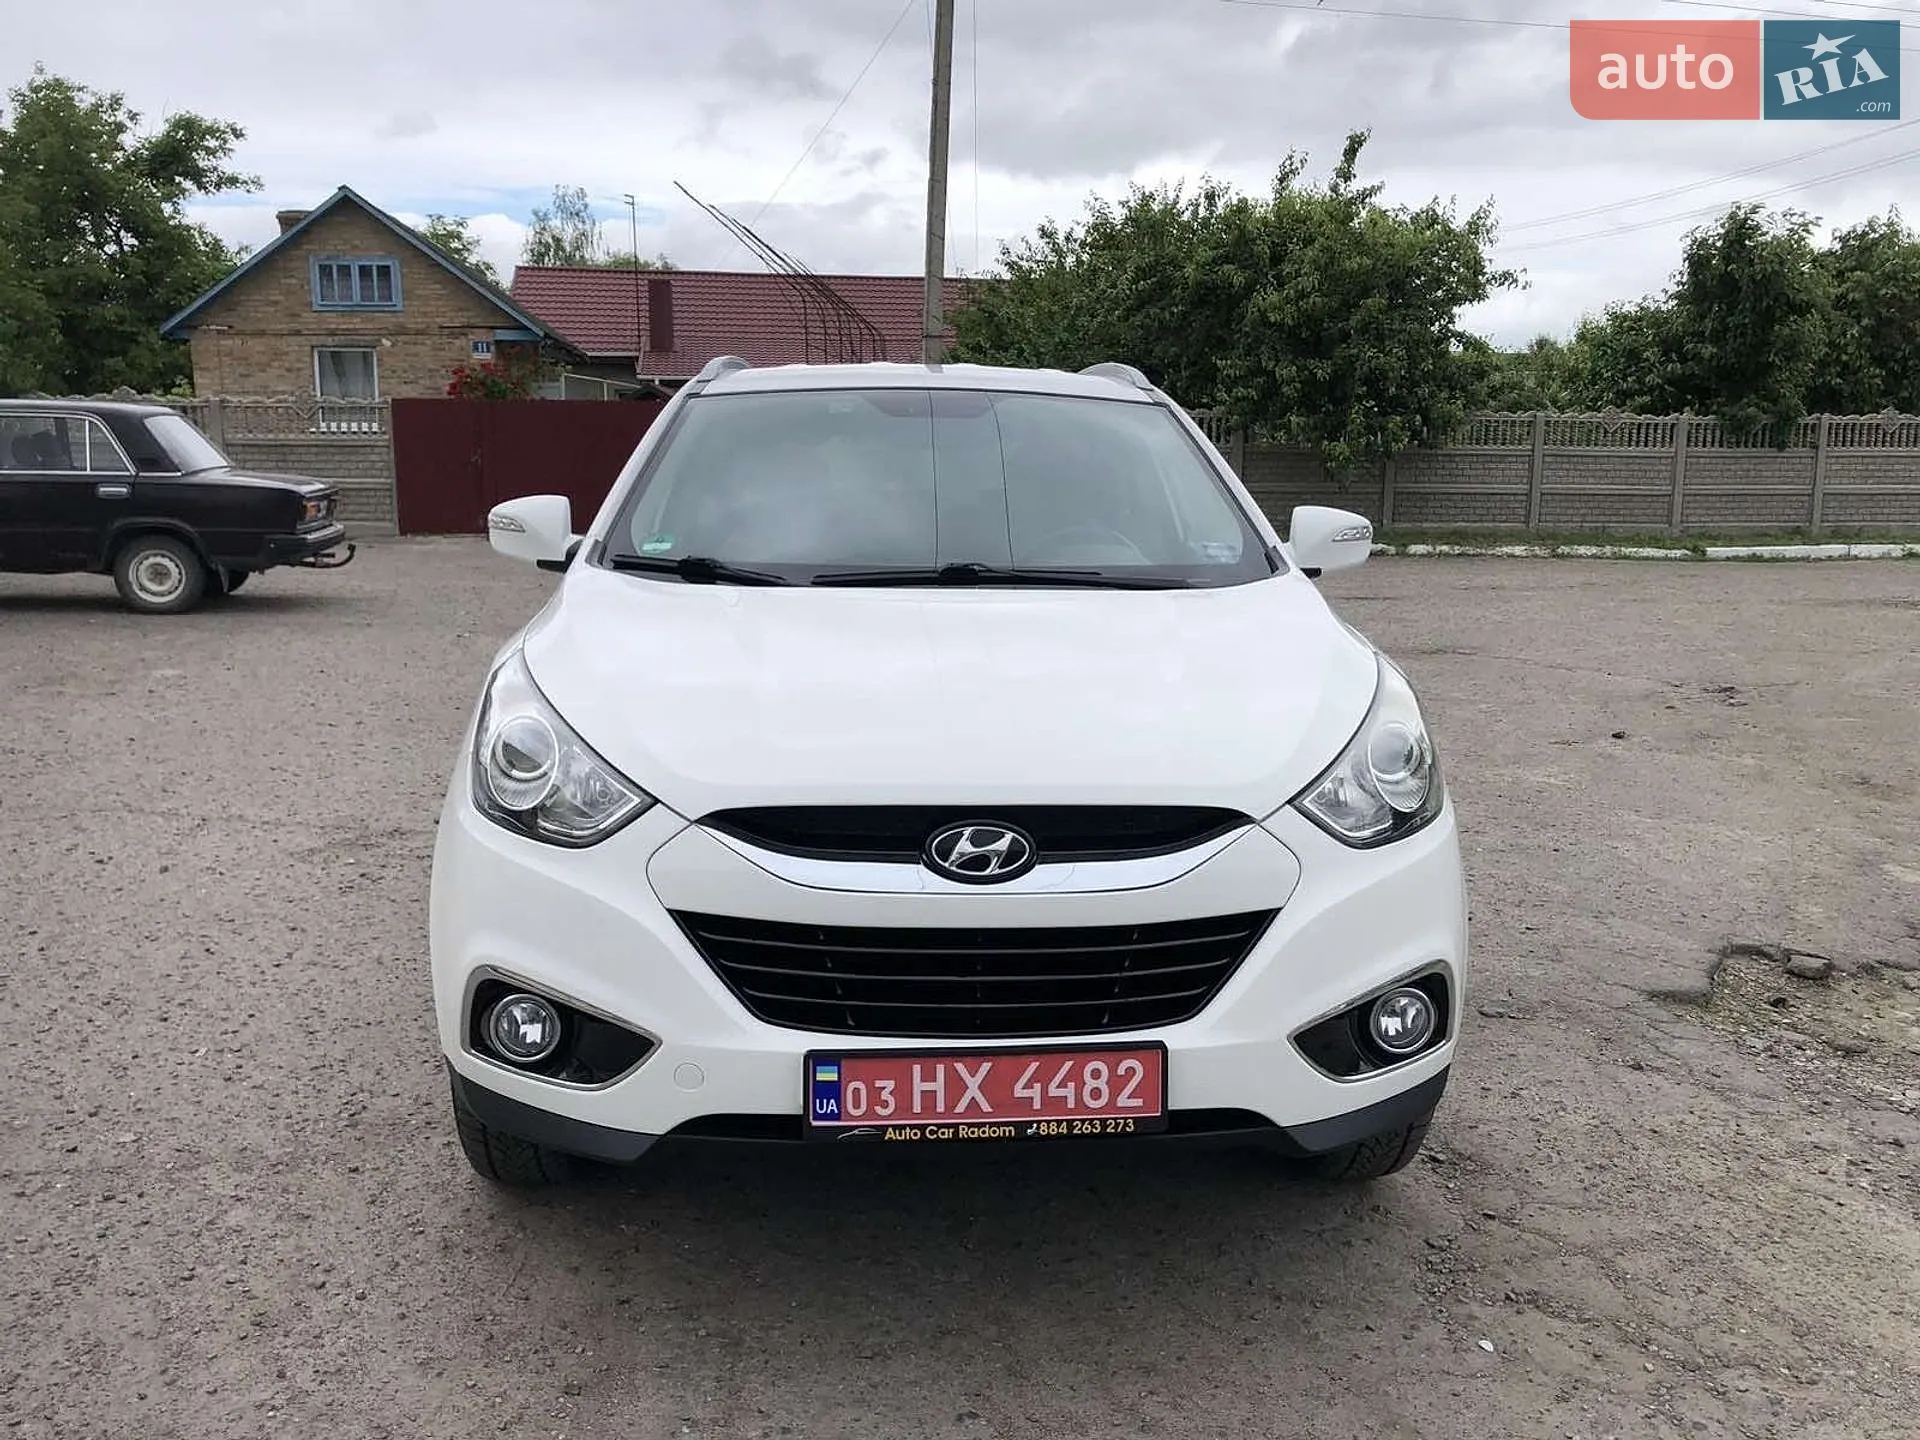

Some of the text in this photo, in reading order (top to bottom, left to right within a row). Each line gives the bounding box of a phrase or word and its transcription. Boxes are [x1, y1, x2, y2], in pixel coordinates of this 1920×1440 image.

[846, 1058, 1145, 1117] 03 HX 4482
[815, 1098, 839, 1114] UA
[884, 1119, 1135, 1141] Auto Car Radom 884 263 273
